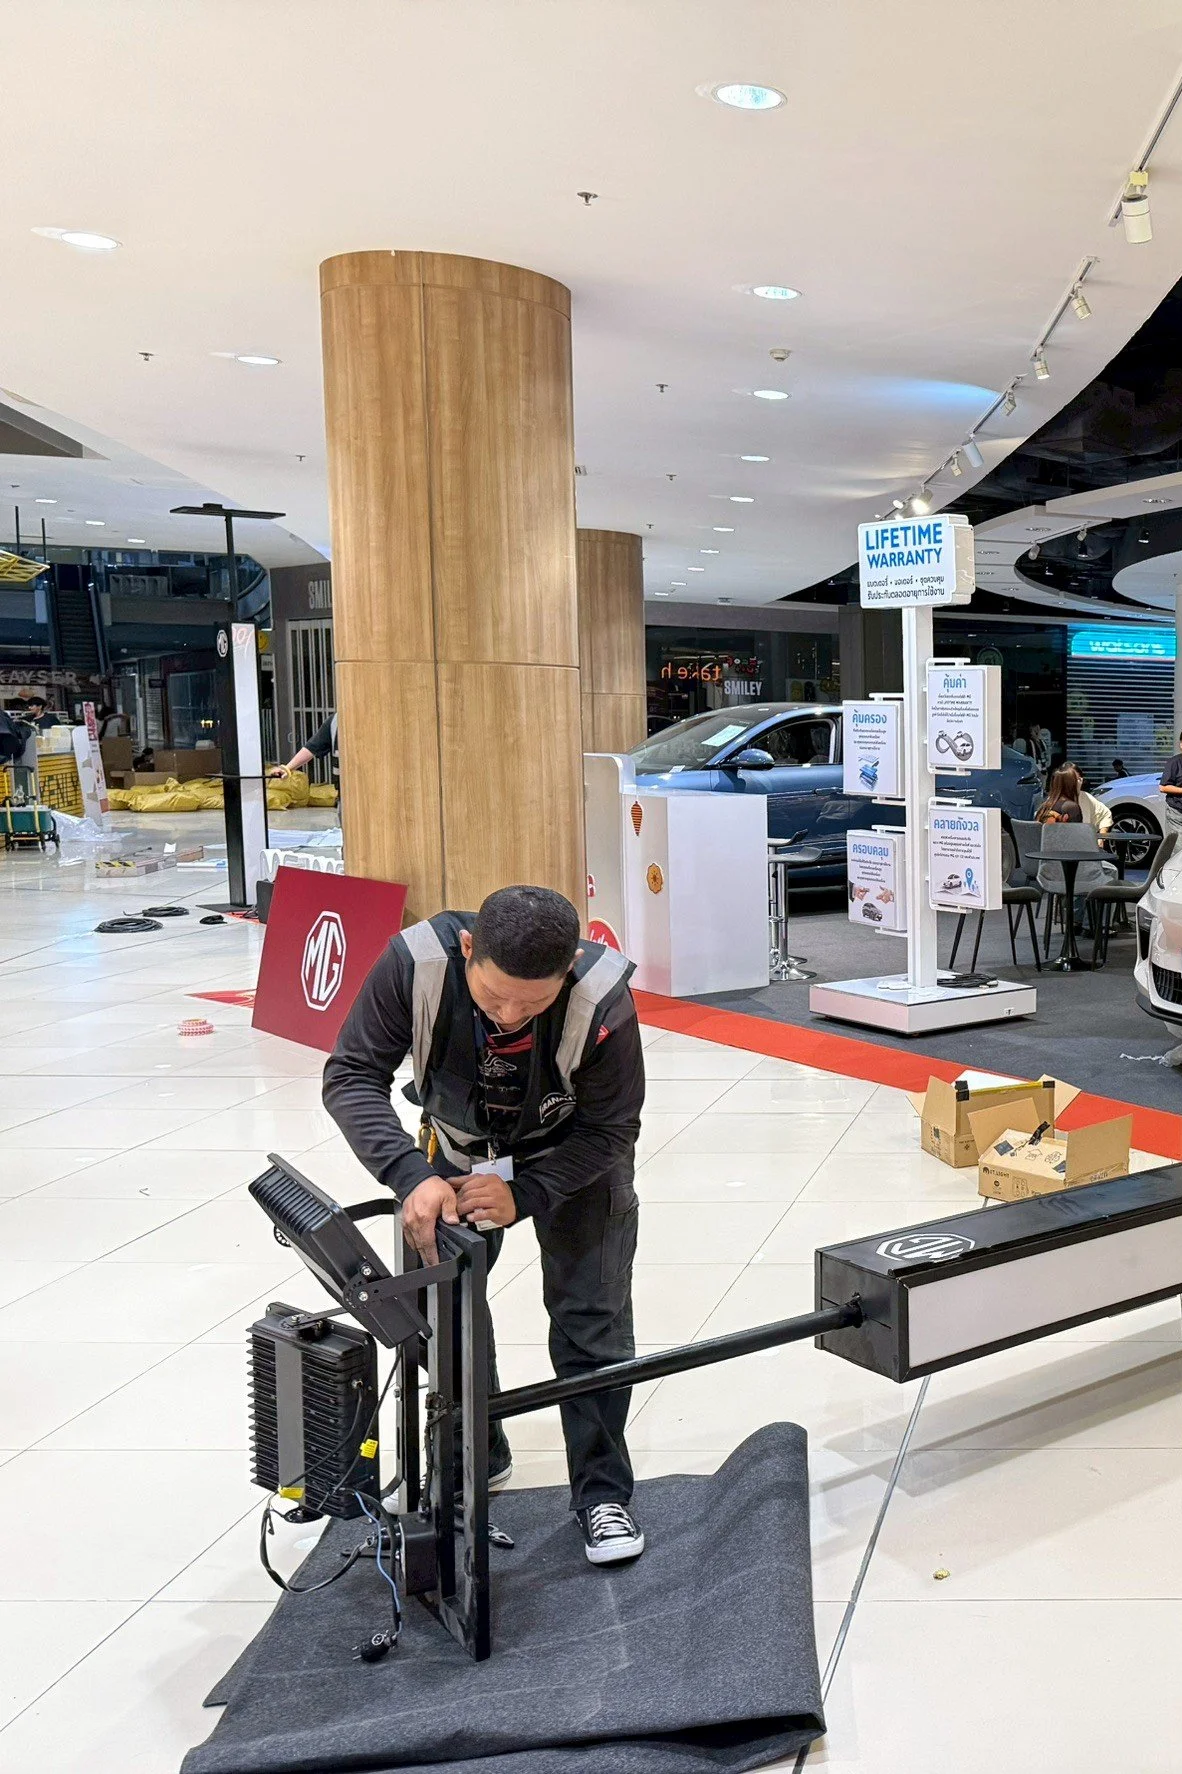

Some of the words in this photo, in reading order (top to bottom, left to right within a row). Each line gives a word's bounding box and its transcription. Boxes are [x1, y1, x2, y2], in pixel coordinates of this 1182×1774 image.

[866, 523, 942, 550] LIFETIME
[867, 548, 942, 569] WARRANTY
[724, 680, 762, 696] SMILEY
[943, 674, 967, 693] คุ้มค่า
[852, 709, 887, 728] คุ้มครอง
[933, 816, 979, 832] คลายกังวล
[852, 843, 889, 860] ครอบคลุม
[304, 919, 344, 1003] MG
[888, 1235, 966, 1261] MG
